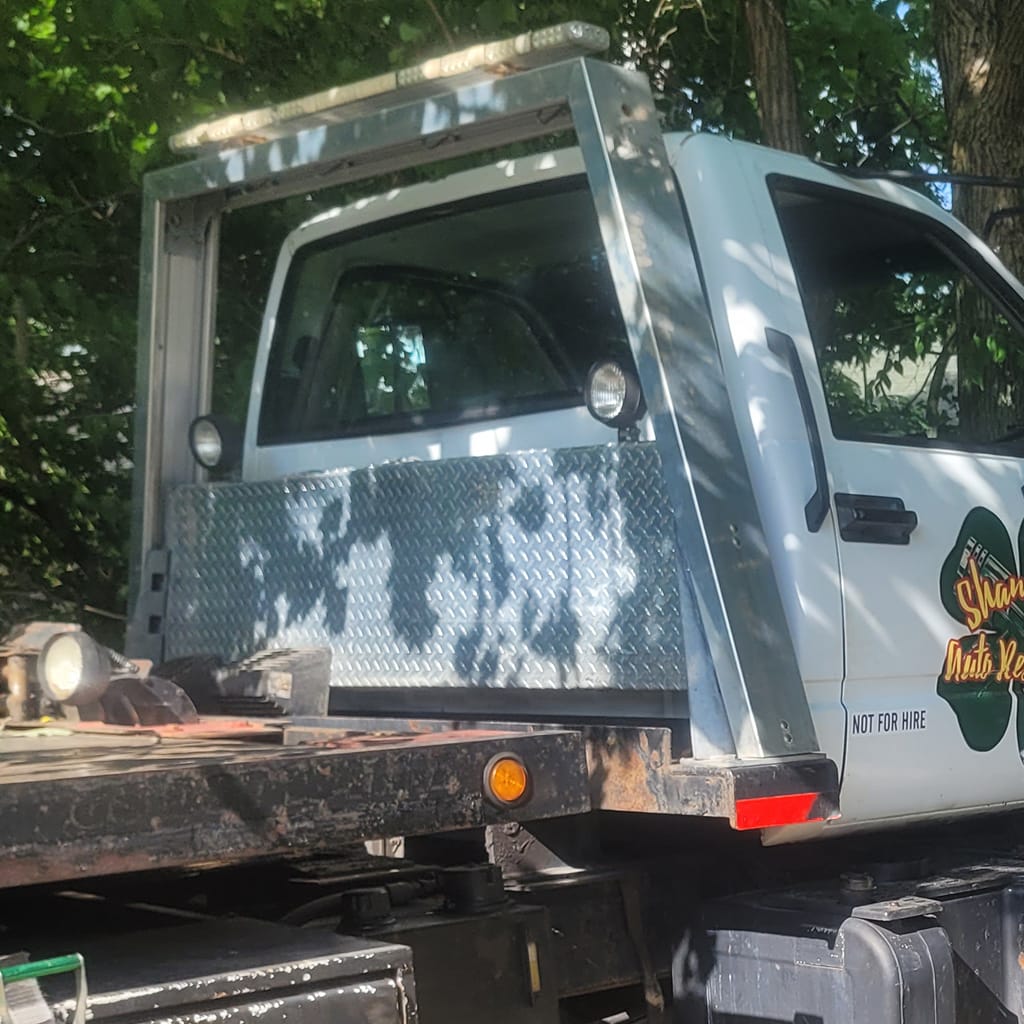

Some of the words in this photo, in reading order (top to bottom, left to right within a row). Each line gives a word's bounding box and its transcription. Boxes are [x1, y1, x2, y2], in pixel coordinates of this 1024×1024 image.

[945, 631, 992, 682] Auto
[852, 713, 874, 735] NOT
[878, 712, 898, 732] FOR
[902, 710, 926, 731] HIRE
